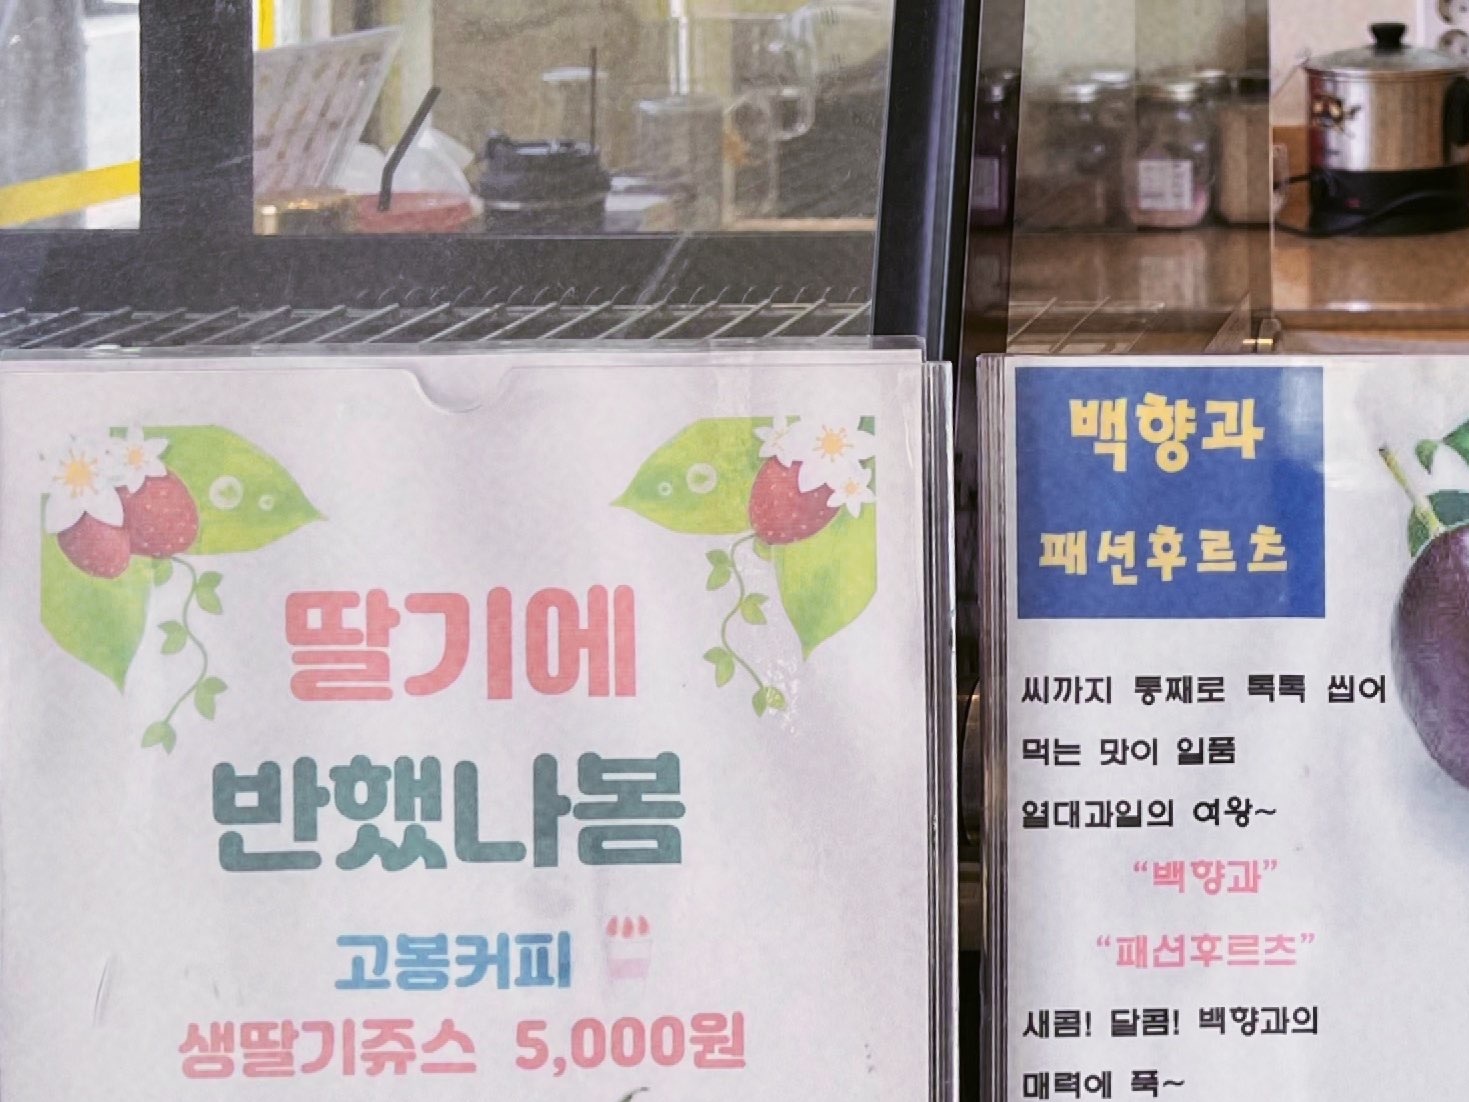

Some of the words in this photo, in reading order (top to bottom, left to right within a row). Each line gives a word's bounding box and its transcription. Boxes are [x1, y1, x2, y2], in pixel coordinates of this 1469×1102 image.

[1069, 392, 1265, 473] 백향과
[1039, 524, 1288, 586] 패션후르츠
[285, 584, 636, 701] 딸기에
[1021, 675, 1113, 705] 씨까지
[1134, 675, 1226, 706] 통째로
[1328, 674, 1386, 704] 씹어
[1022, 737, 1081, 766] 먹는
[1100, 737, 1159, 766] 맛이
[1177, 736, 1236, 766] 일품
[212, 751, 685, 871] 반했나봄
[1021, 799, 1174, 829] 열대과일의
[1193, 796, 1278, 828] 여왕~
[335, 931, 571, 991] 고봉커피
[178, 1017, 477, 1079] 생딸기쥬스
[515, 1011, 746, 1077] 5,000원
[1022, 1009, 1092, 1038] 새콤!
[1110, 1008, 1180, 1037] 달콤!
[1199, 1005, 1319, 1036] 백향과의
[1022, 1071, 1113, 1100] 매력에
